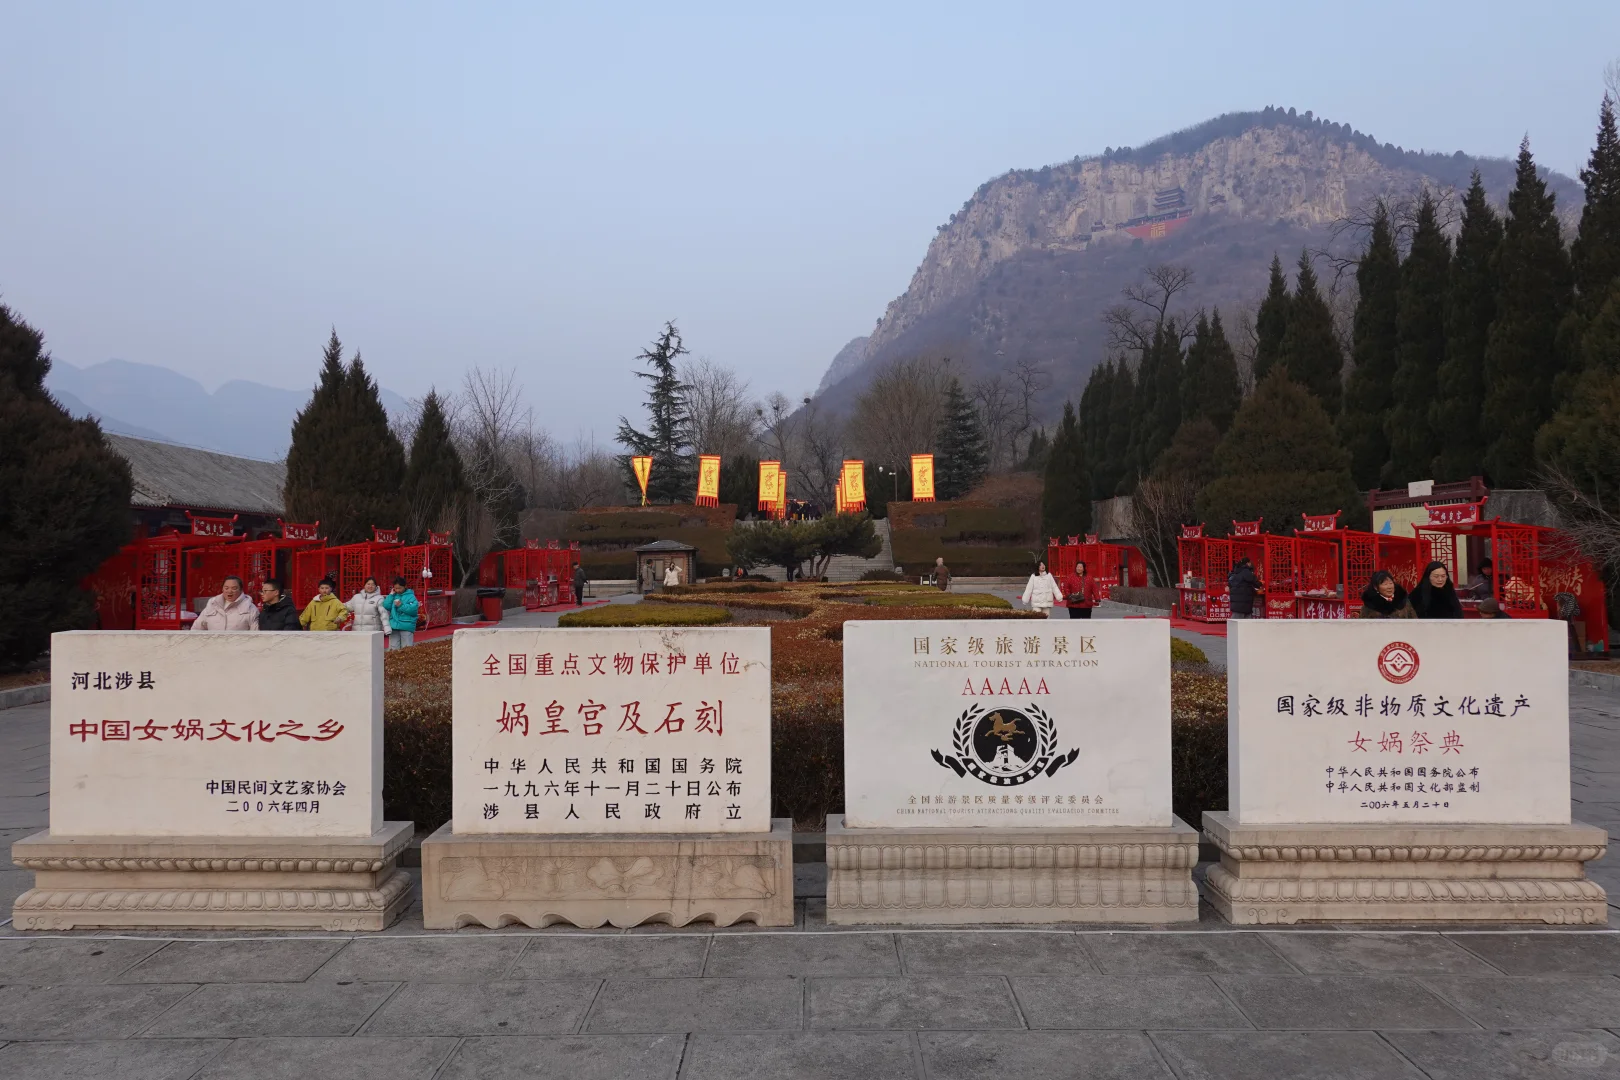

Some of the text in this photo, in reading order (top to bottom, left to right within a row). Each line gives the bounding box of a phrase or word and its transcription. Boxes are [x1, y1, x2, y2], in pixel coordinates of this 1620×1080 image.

[914, 635, 1097, 655] 国家级旅游景区
[481, 652, 741, 676] 全国重点文物保护单位
[914, 659, 1099, 668] NATIONAL TOURIST ATTRACTION
[71, 671, 156, 690] 河北涉县
[961, 677, 1051, 696] AAAAA
[1277, 693, 1531, 718] 国家级非物质文化遗产
[496, 699, 723, 737] 娲皇宫及石刻
[69, 719, 345, 743] 中国女娲文化之乡
[1347, 730, 1465, 755] 女娲祭典
[484, 757, 743, 775] 中华人民共和国国务院
[1325, 766, 1480, 779] 中华人民共和国国务院公布
[206, 779, 347, 796] 中国民间文艺家协会
[483, 780, 742, 797] 一九九六年十一月二十日公布
[1325, 780, 1480, 794] 中华人民共和国文化部监制
[908, 795, 1103, 805] 全国旅游景区质量等级评定委员会
[483, 803, 742, 820] 涉县人民政府立
